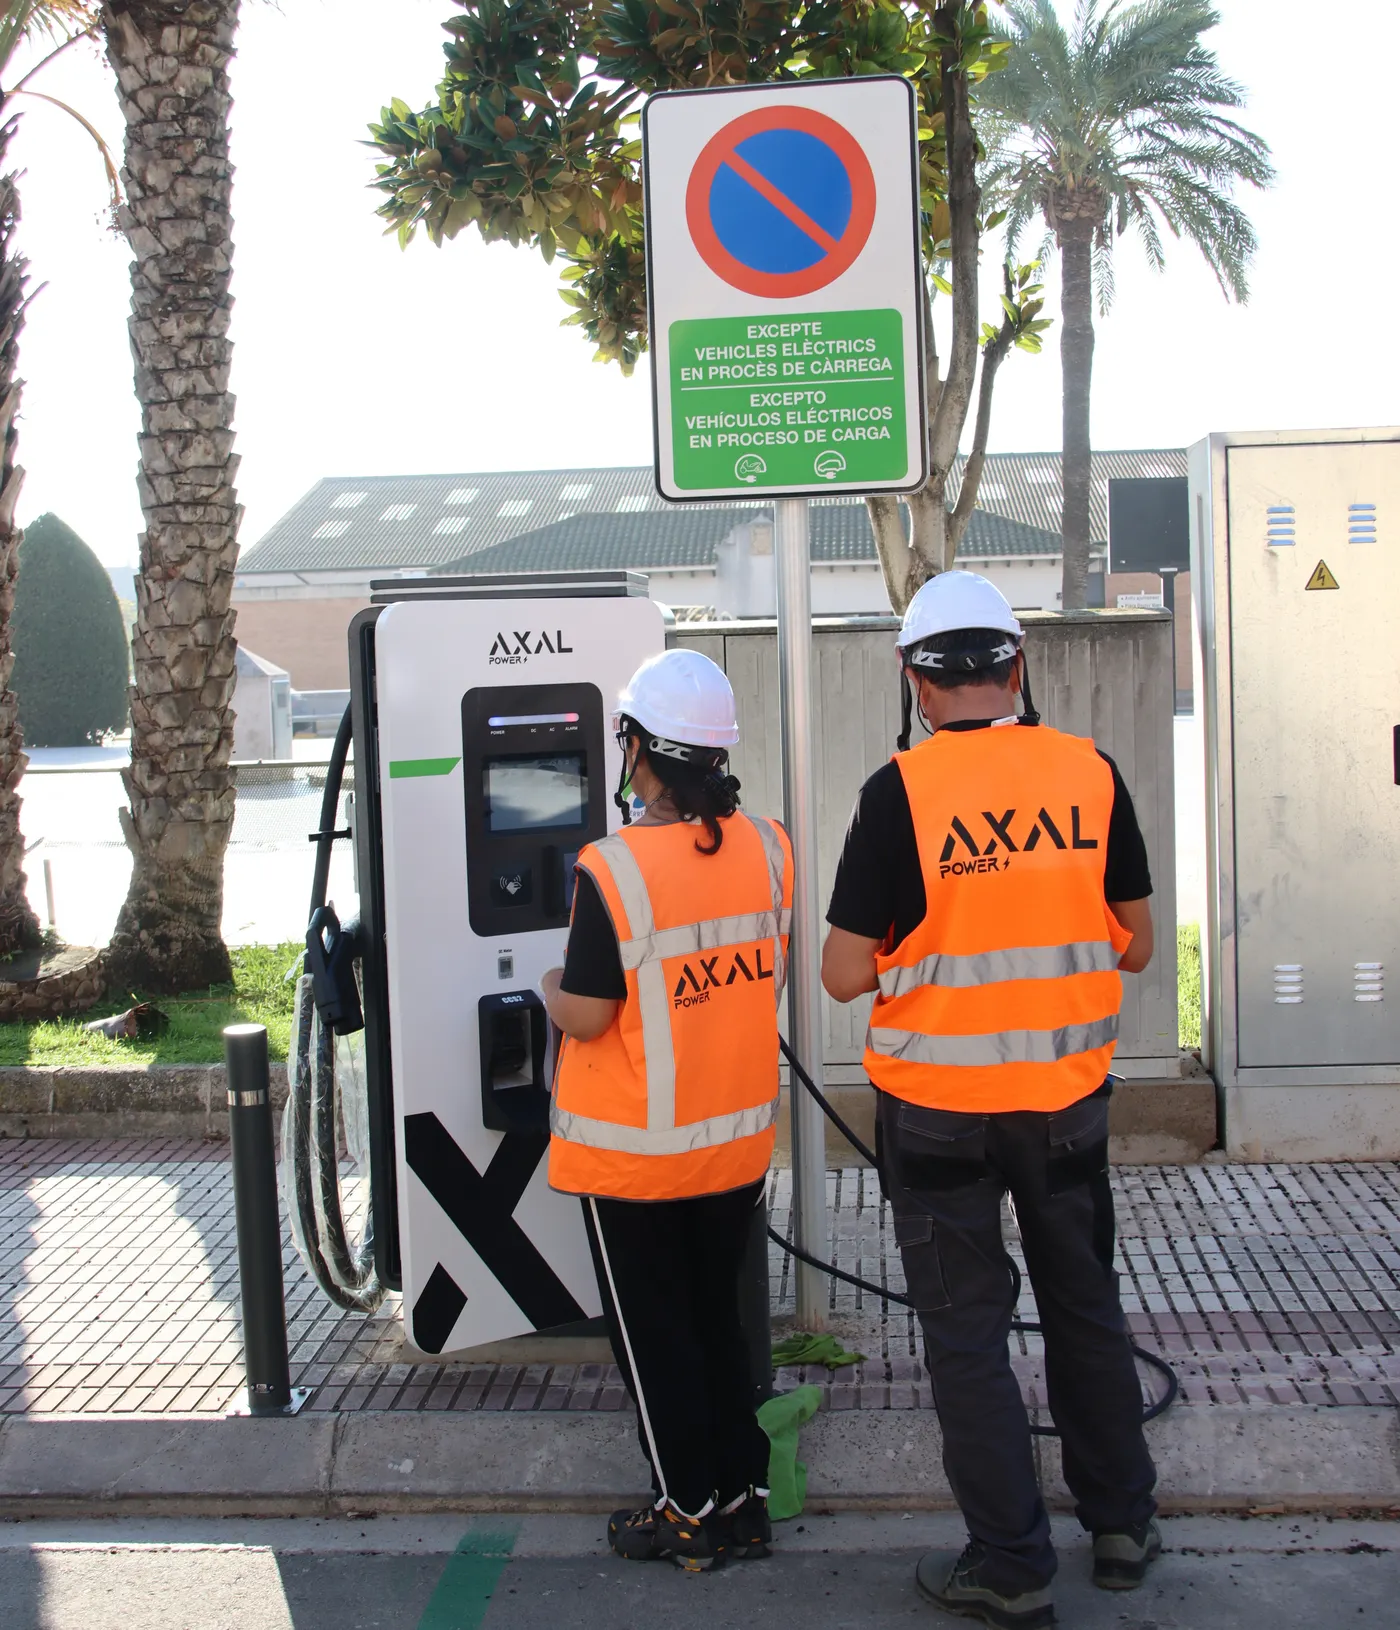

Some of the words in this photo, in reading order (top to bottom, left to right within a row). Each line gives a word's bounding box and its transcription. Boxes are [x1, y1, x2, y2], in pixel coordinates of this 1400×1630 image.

[747, 321, 822, 339] EXCEPTE
[695, 343, 777, 361] VEHICLES
[782, 338, 876, 357] ELÈCTRICS
[681, 367, 703, 381] EN
[708, 359, 778, 380] PROCÈS
[782, 361, 805, 376] DE
[810, 357, 893, 375] CÀRREGA
[750, 390, 826, 408] EXCEPTO
[685, 411, 781, 430] VEHÍCULOS
[786, 406, 893, 425] ELÉCTRICOS
[689, 434, 712, 449] EN
[717, 430, 799, 448] PROCESO
[804, 429, 827, 444] DE
[831, 426, 891, 442] CARGA
[489, 630, 573, 656] AXAL
[489, 656, 522, 665] POWER
[939, 805, 1098, 863] AXAL
[939, 857, 1000, 879] POWER
[674, 948, 773, 997] AXAL
[501, 995, 524, 1004] CCS2
[674, 991, 710, 1010] POWER
